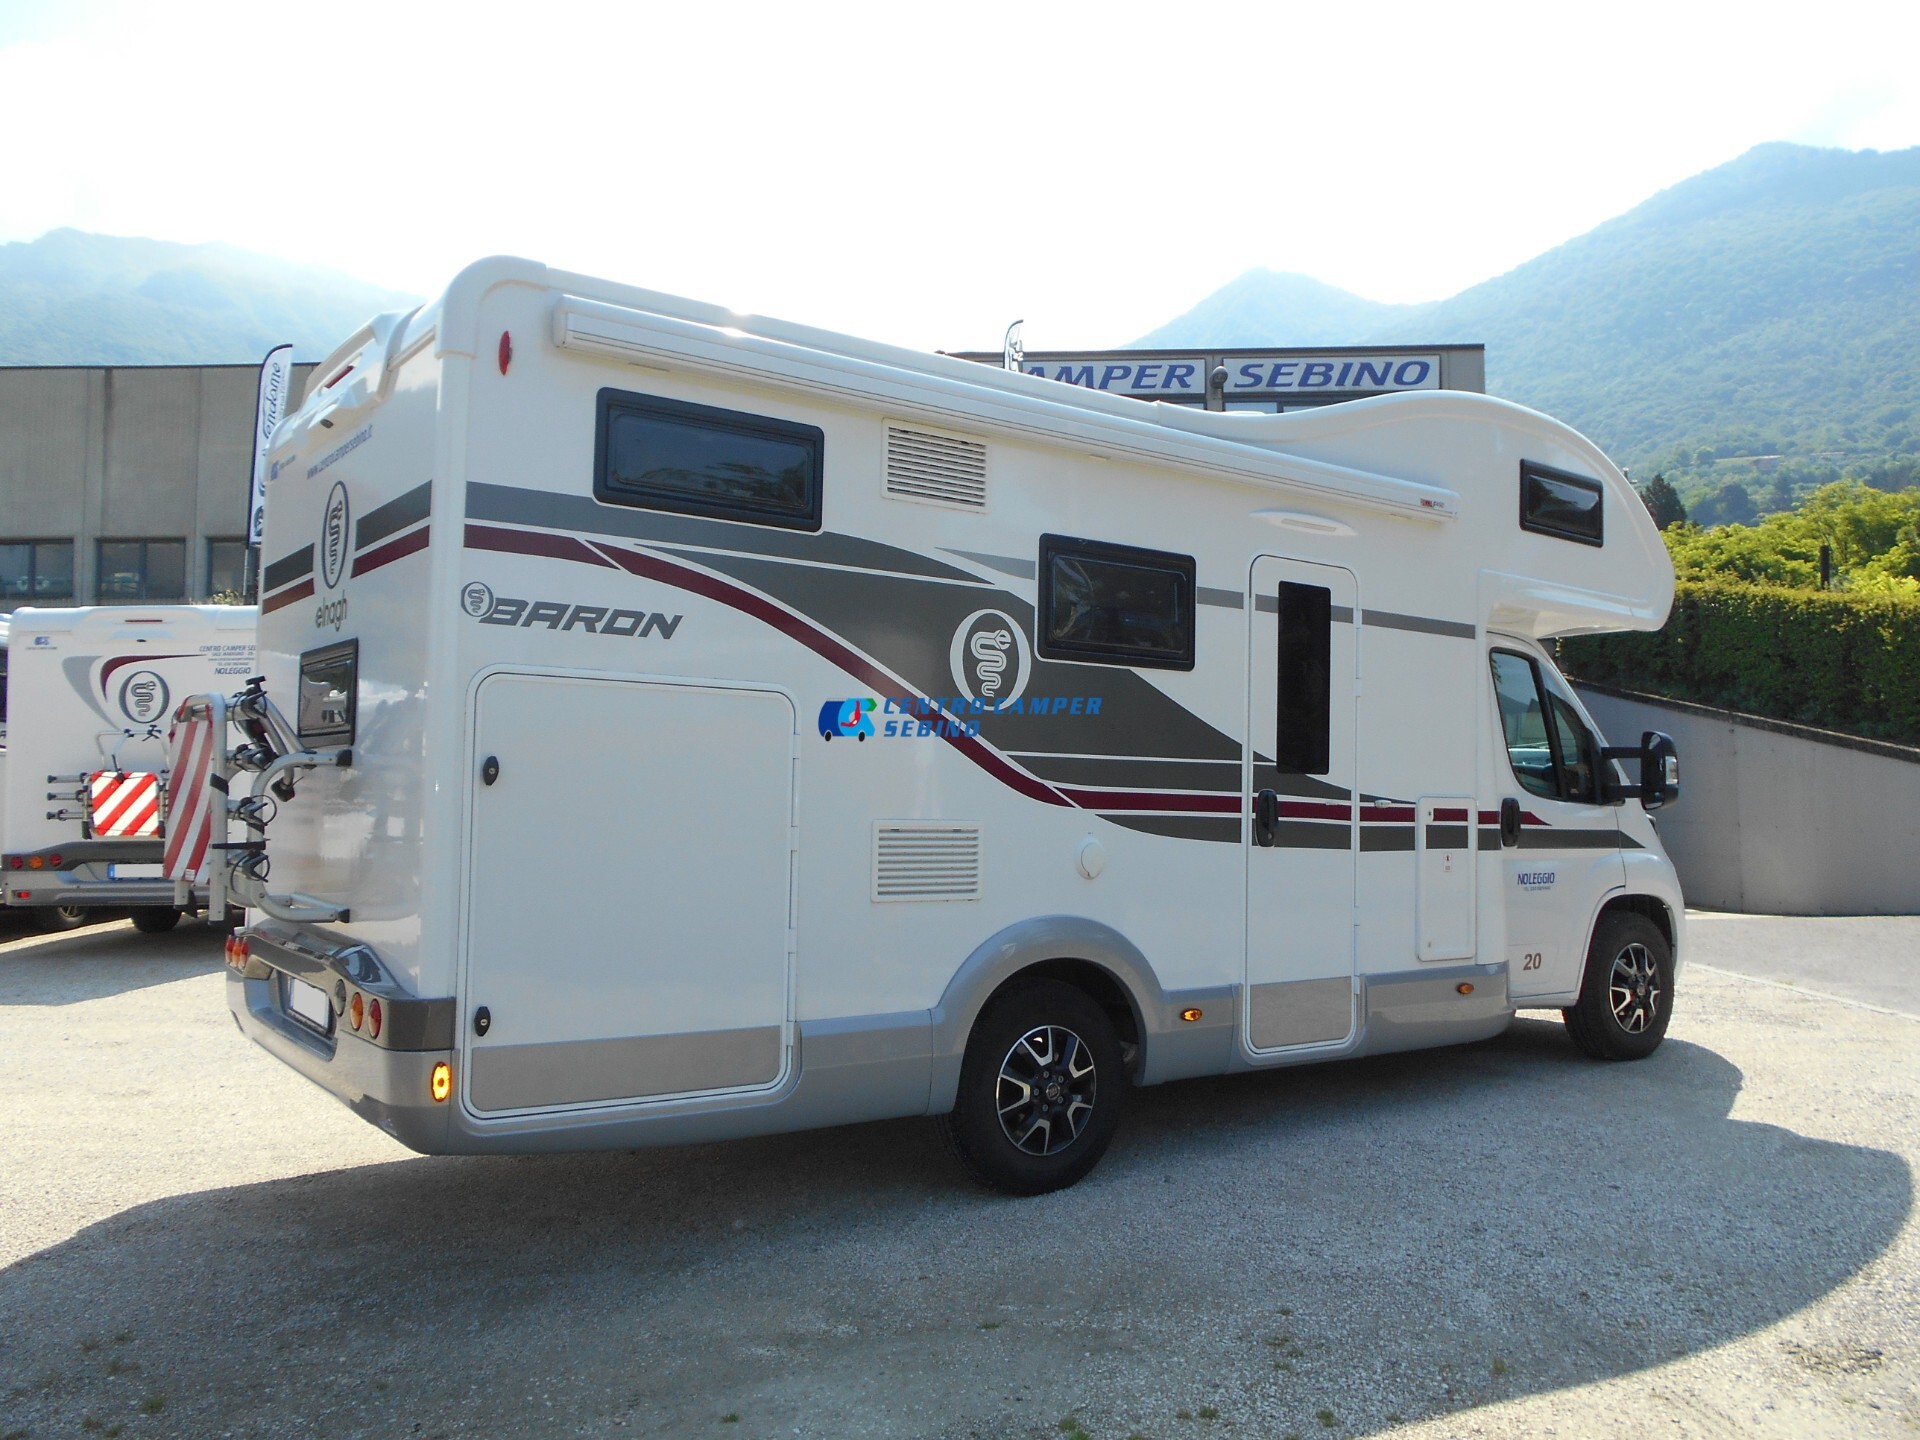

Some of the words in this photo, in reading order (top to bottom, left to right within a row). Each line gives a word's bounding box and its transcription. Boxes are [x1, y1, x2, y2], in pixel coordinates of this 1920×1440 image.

[1234, 361, 1430, 388] SEBINO
[315, 589, 347, 632] elnagh
[478, 597, 684, 640] BARON
[215, 667, 251, 675] NOLEGGIO
[1517, 872, 1555, 885] NOLEGGIO
[1523, 953, 1541, 970] 20
